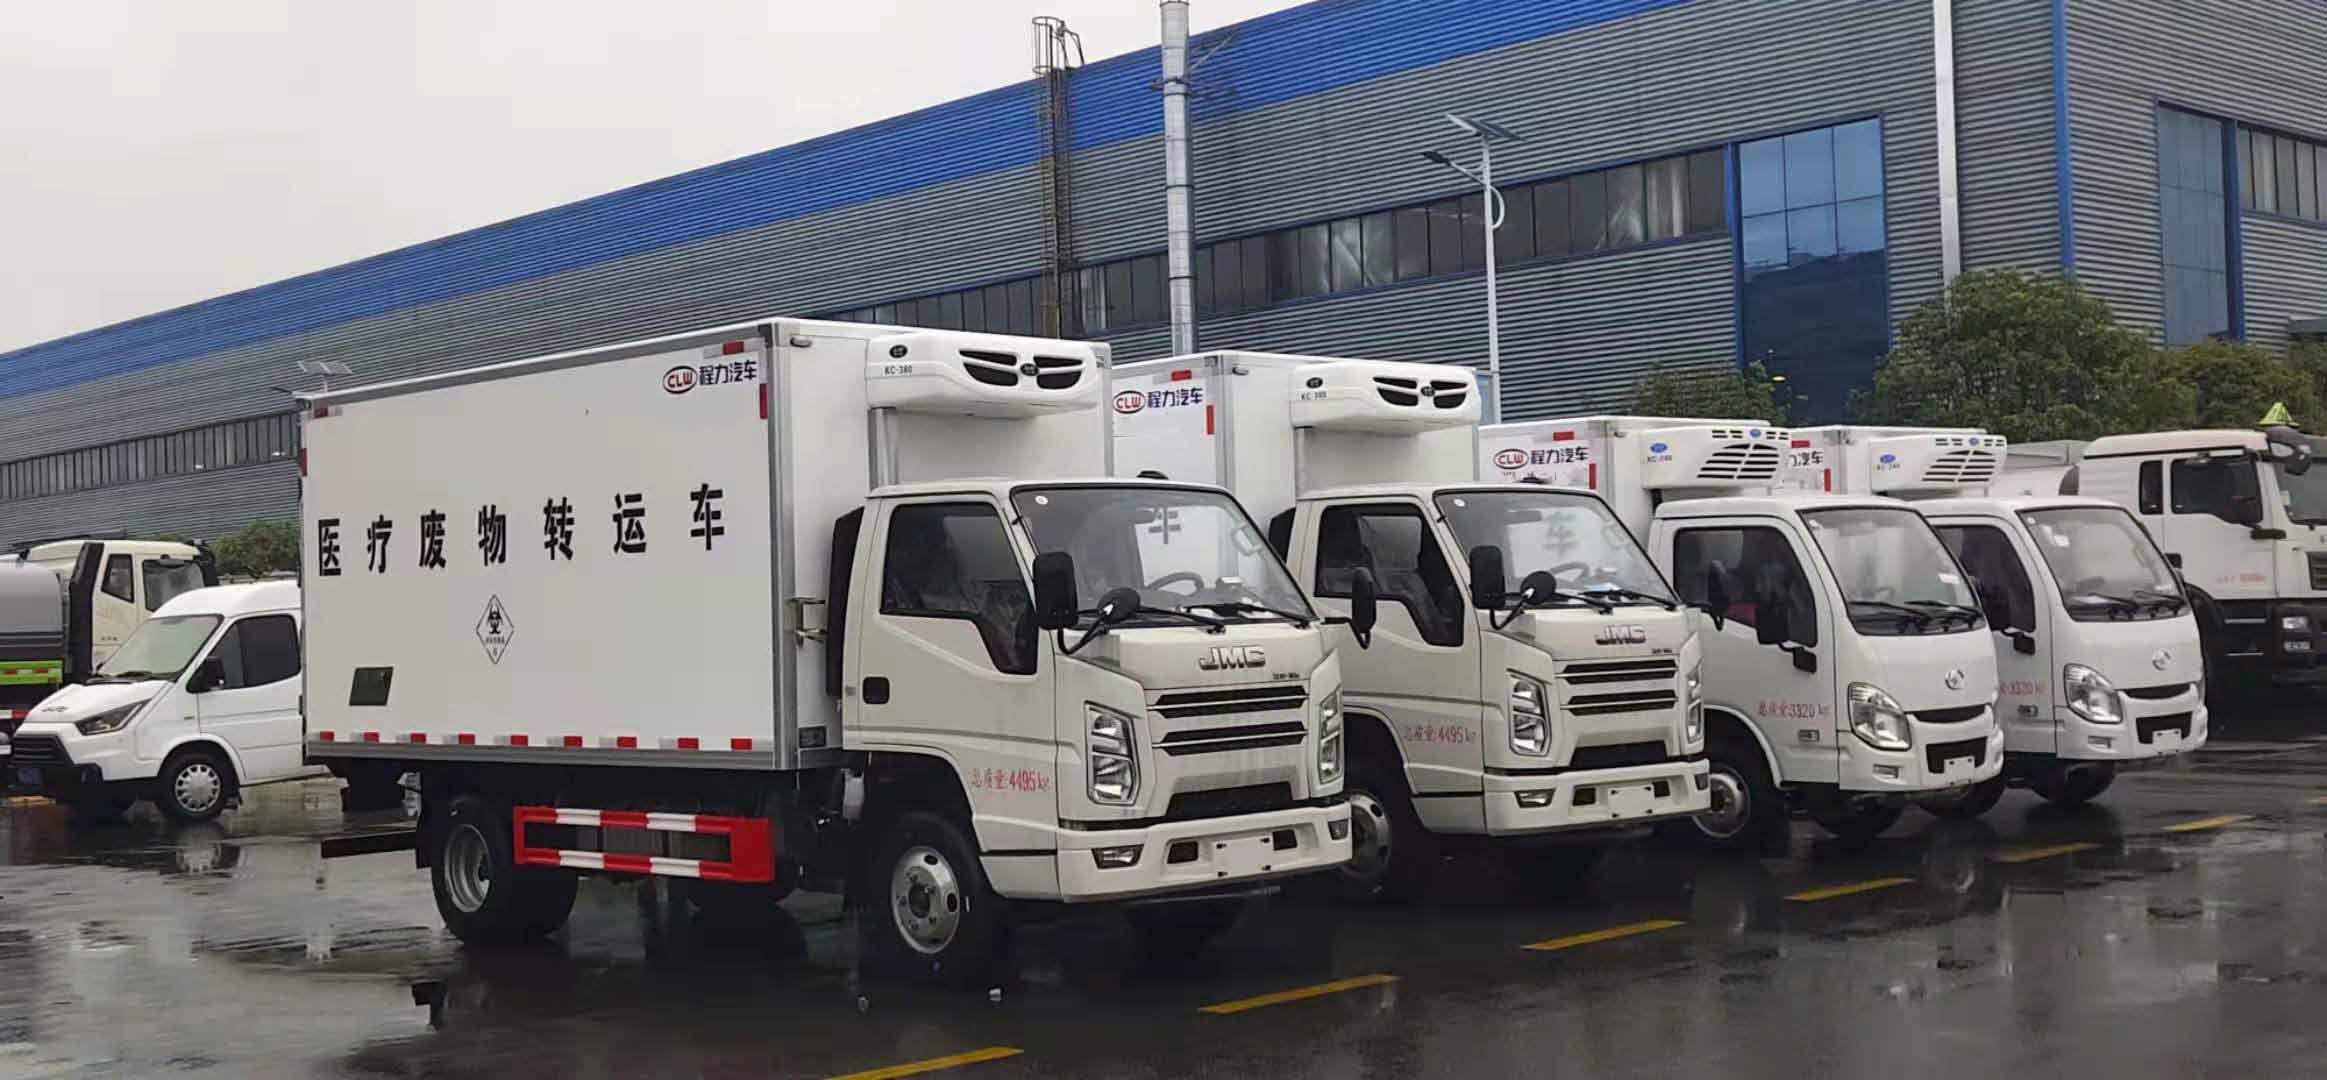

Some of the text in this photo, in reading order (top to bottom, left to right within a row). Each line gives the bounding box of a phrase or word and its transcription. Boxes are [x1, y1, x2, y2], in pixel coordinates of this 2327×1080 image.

[699, 359, 757, 385] 程力汽车
[1147, 387, 1203, 408] 程力汽车
[1531, 446, 1588, 465] 程力汽车
[318, 483, 725, 577] 医疗废物转运车
[1594, 624, 1647, 645] JMC
[1199, 646, 1266, 671] JMC
